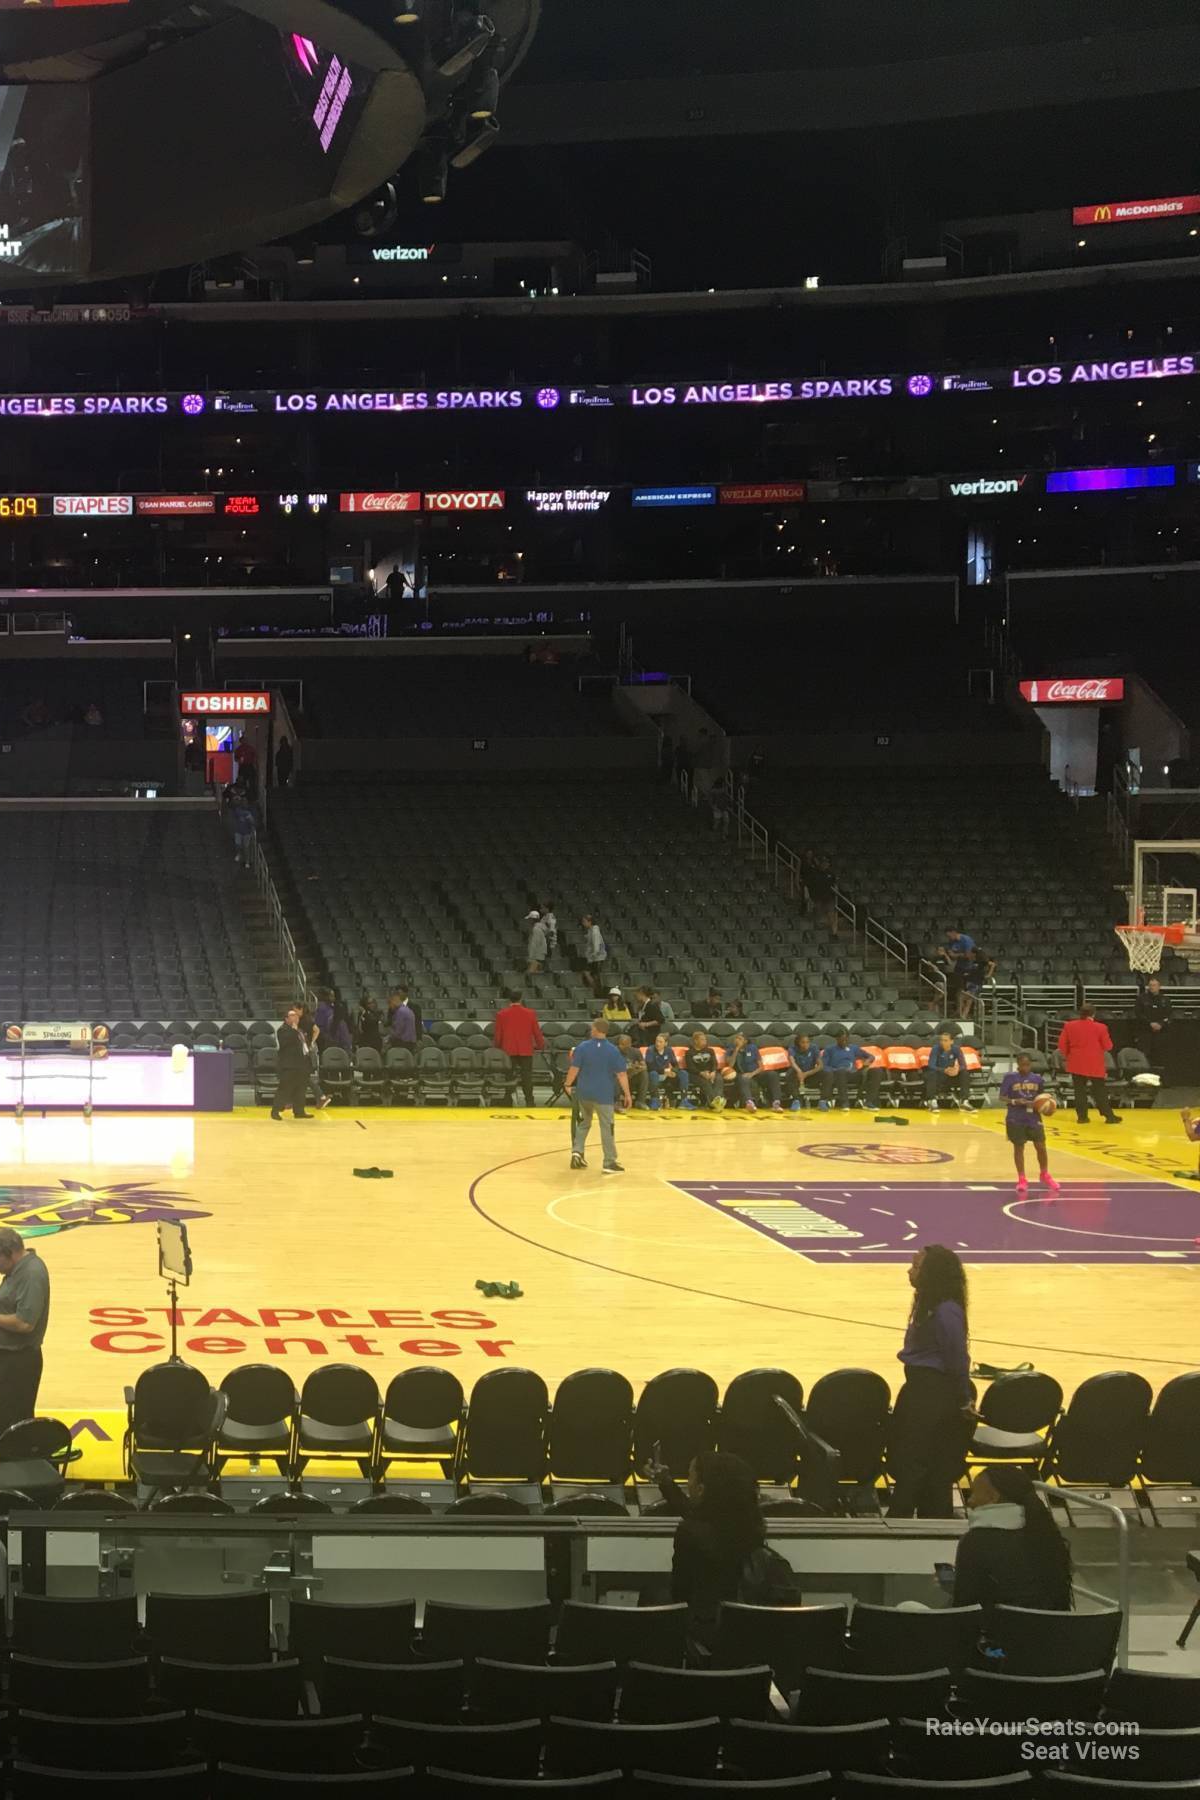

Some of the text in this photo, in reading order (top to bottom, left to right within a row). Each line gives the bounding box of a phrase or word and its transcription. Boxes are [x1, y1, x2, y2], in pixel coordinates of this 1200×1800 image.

[1116, 202, 1183, 216] McDonald's
[372, 245, 428, 260] verizon
[1012, 356, 1194, 387] LOS ANGELES
[631, 378, 893, 406] LOS ANGELES SPARKS
[84, 396, 168, 414] SPARKS
[275, 390, 522, 412] LOS ANGELES SPARKS
[721, 488, 803, 499] WELLS FARGO
[950, 478, 1019, 496] verizon
[228, 497, 256, 505] TEAM
[279, 494, 298, 504] LAS
[308, 494, 328, 504] MIN
[425, 493, 503, 509] TOYOTA
[527, 490, 610, 502] Happy Birthday
[0, 498, 37, 516] 6:09
[55, 497, 130, 514] STAPLES
[144, 500, 214, 509] SAN MANUEL CASINO
[225, 504, 259, 513] FOULS
[536, 500, 599, 511] Jean Morris
[183, 696, 268, 711] TOSHIBA
[88, 1307, 497, 1329] STAPLES
[90, 1330, 516, 1358] Center
